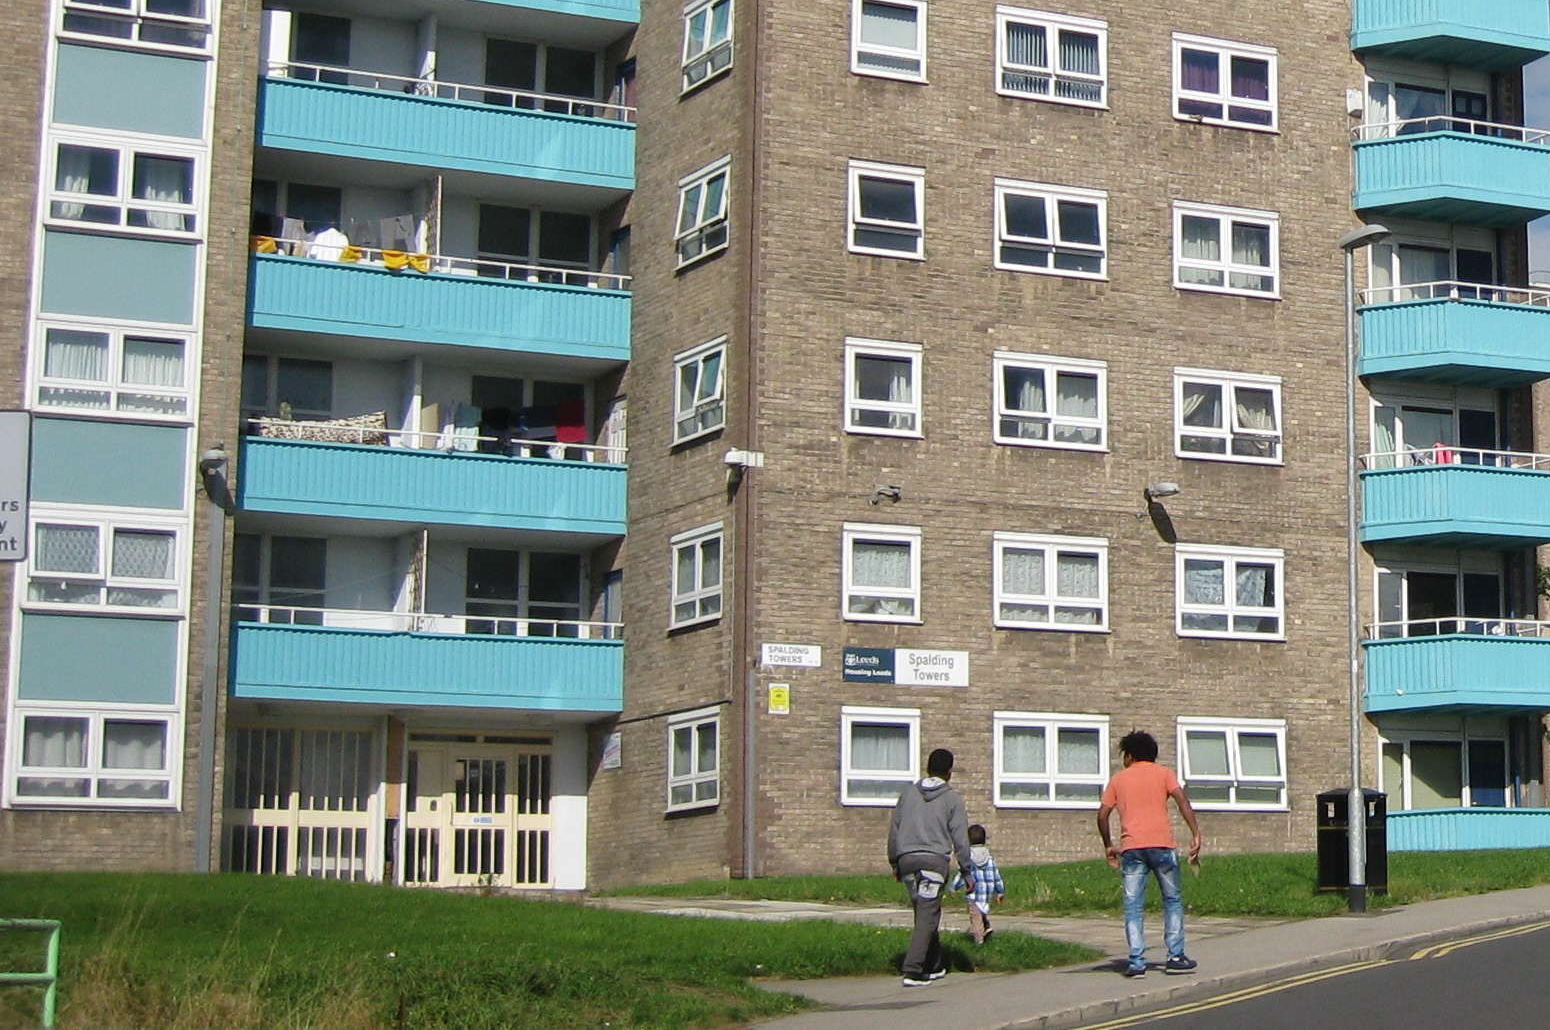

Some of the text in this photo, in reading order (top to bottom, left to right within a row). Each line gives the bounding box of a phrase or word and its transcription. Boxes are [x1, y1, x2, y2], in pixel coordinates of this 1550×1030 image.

[768, 645, 809, 655] SPALDING
[768, 655, 803, 663] TOWERS
[856, 655, 880, 665] Leeds
[909, 653, 955, 669] Spalding
[913, 669, 950, 681] Towers
